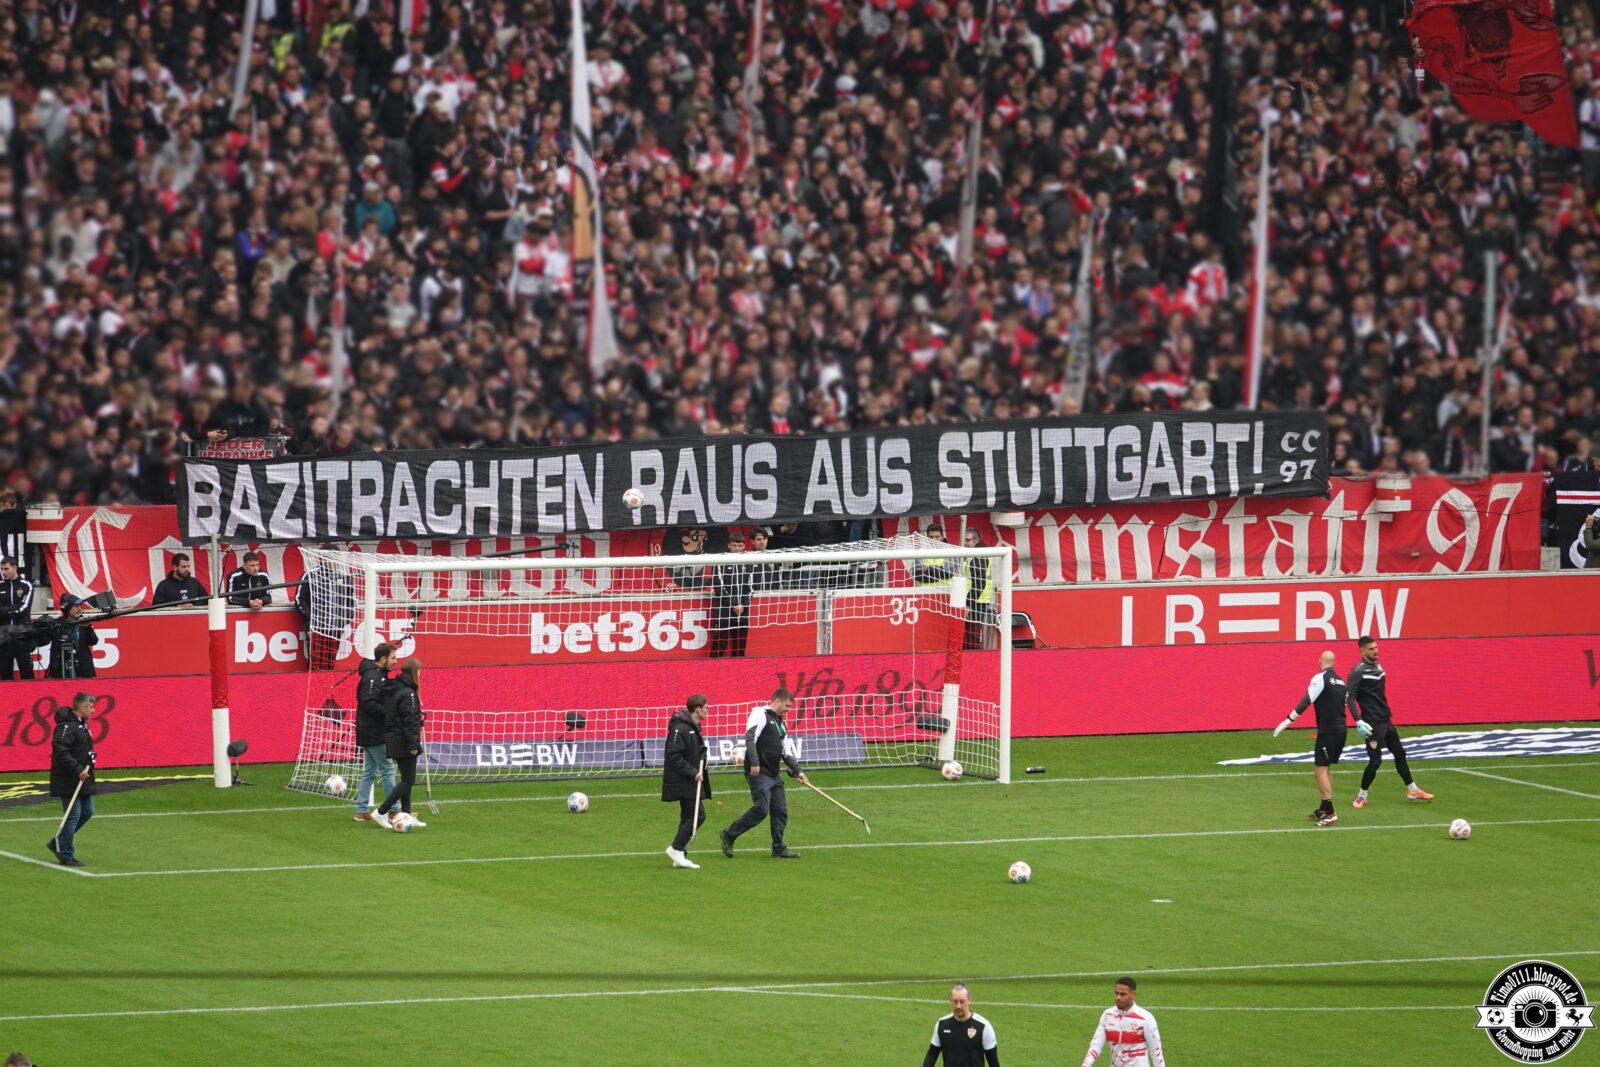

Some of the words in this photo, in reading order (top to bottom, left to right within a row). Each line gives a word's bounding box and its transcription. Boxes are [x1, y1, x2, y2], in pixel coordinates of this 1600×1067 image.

[208, 439, 265, 450] JEDER
[1280, 429, 1321, 454] CC
[185, 453, 604, 540] BAZITRACHTEN
[630, 442, 777, 526] RAUS
[803, 437, 913, 515] AUS
[938, 421, 1264, 508] STUTTGART!
[1279, 458, 1316, 484] 97
[1426, 482, 1523, 573] 97
[530, 611, 709, 655] bet365
[889, 597, 920, 625] 35
[850, 667, 946, 725] 189
[1, 694, 116, 747] 183
